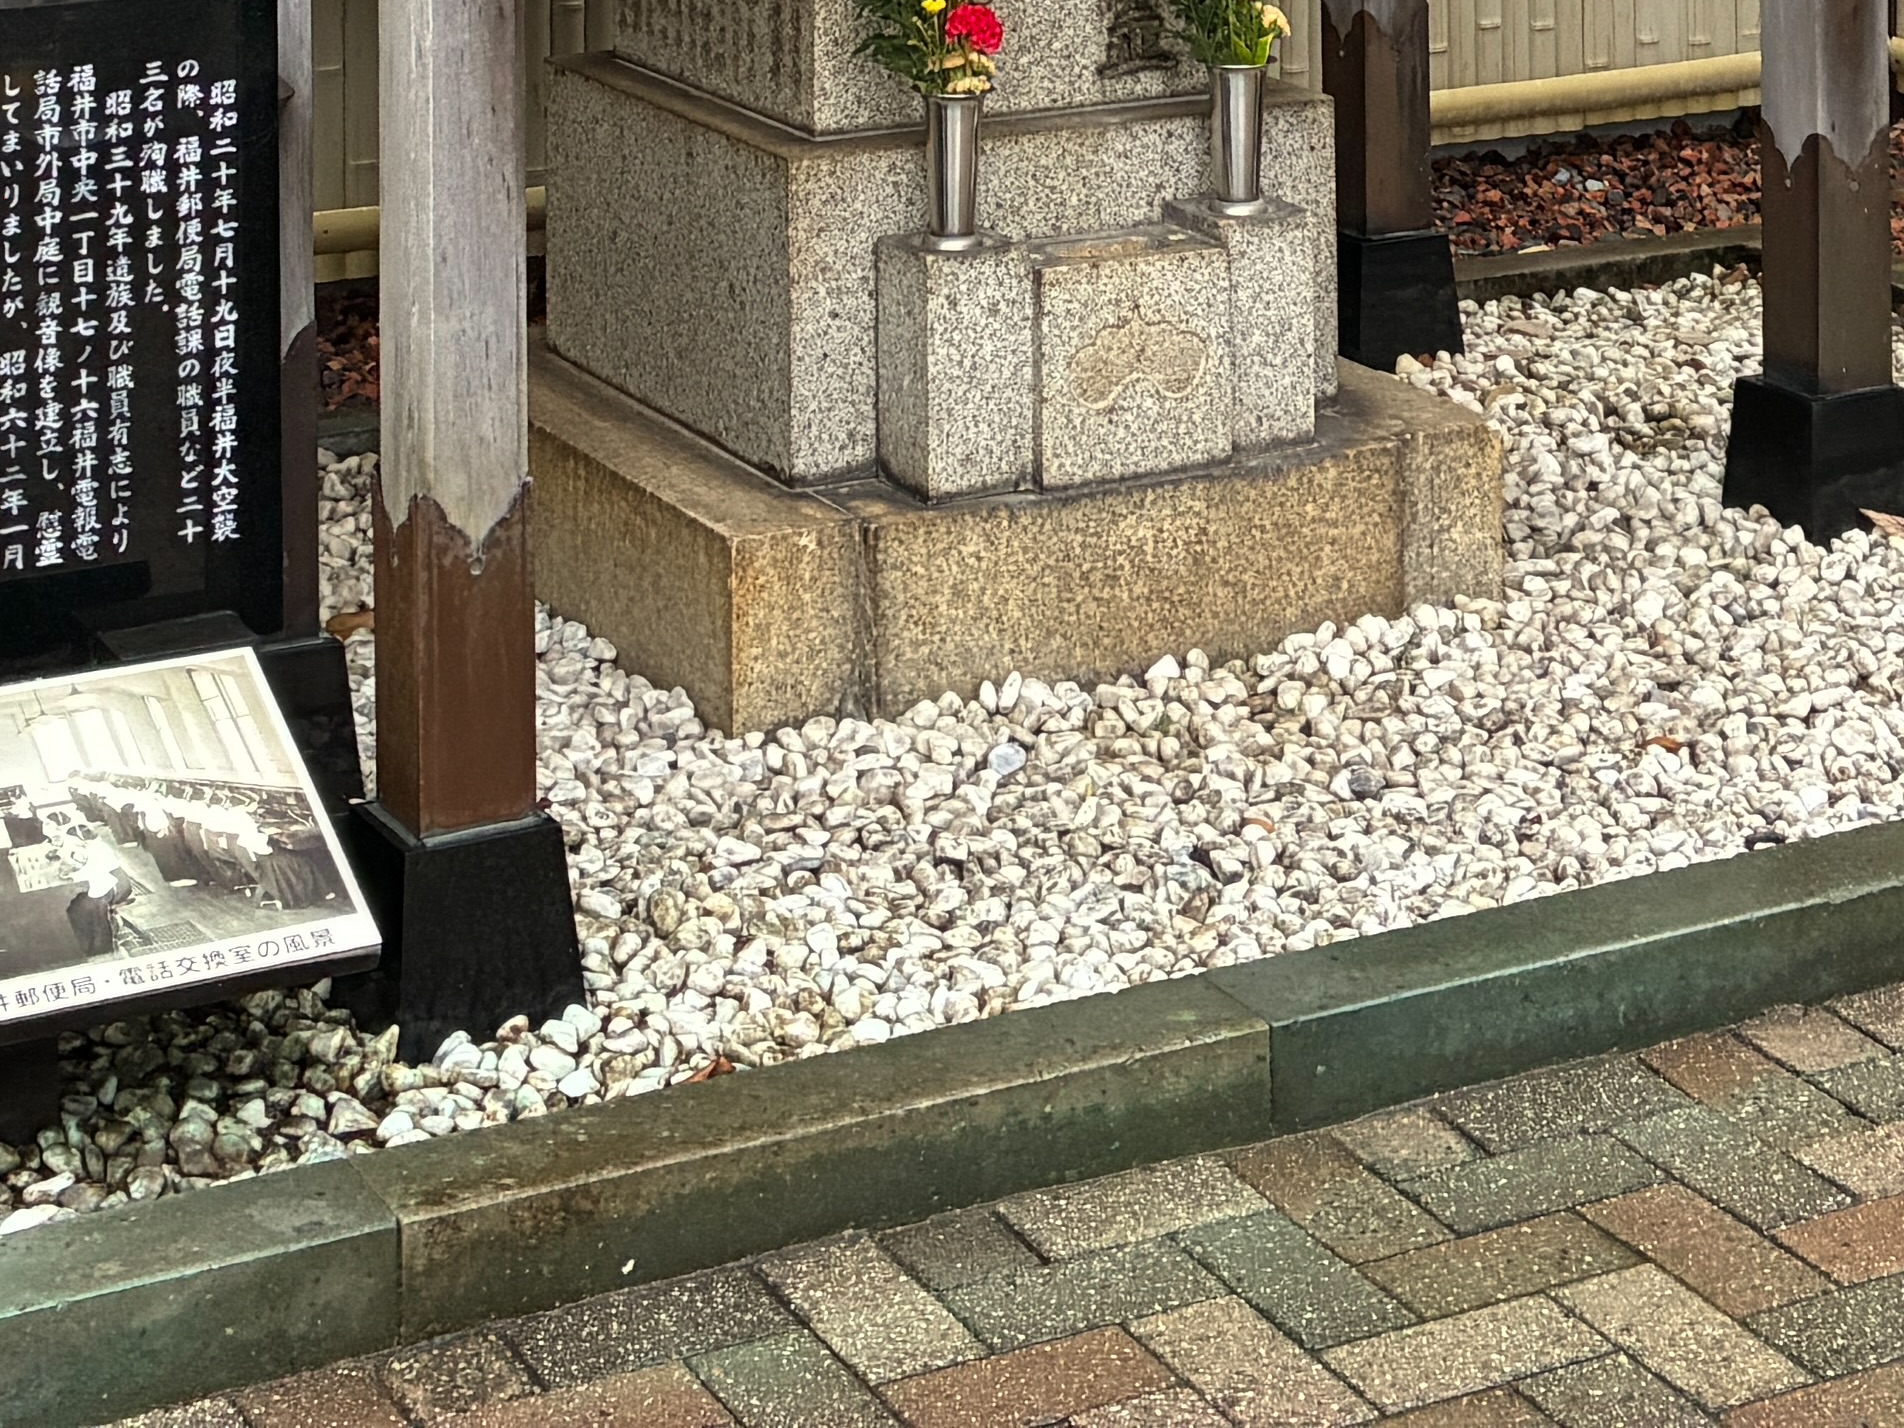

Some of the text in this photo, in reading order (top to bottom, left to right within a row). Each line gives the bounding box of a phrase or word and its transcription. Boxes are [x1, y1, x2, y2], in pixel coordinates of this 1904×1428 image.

[67, 64, 102, 561] 福井市中央一丁目十七ノ十六福井電報電
[104, 89, 136, 553] 昭和三十九年遺族及び職員有志により
[139, 61, 169, 312] 三名が殉職しました。
[209, 79, 240, 542] 昭和二十年七月十九日夜半福井大空襲
